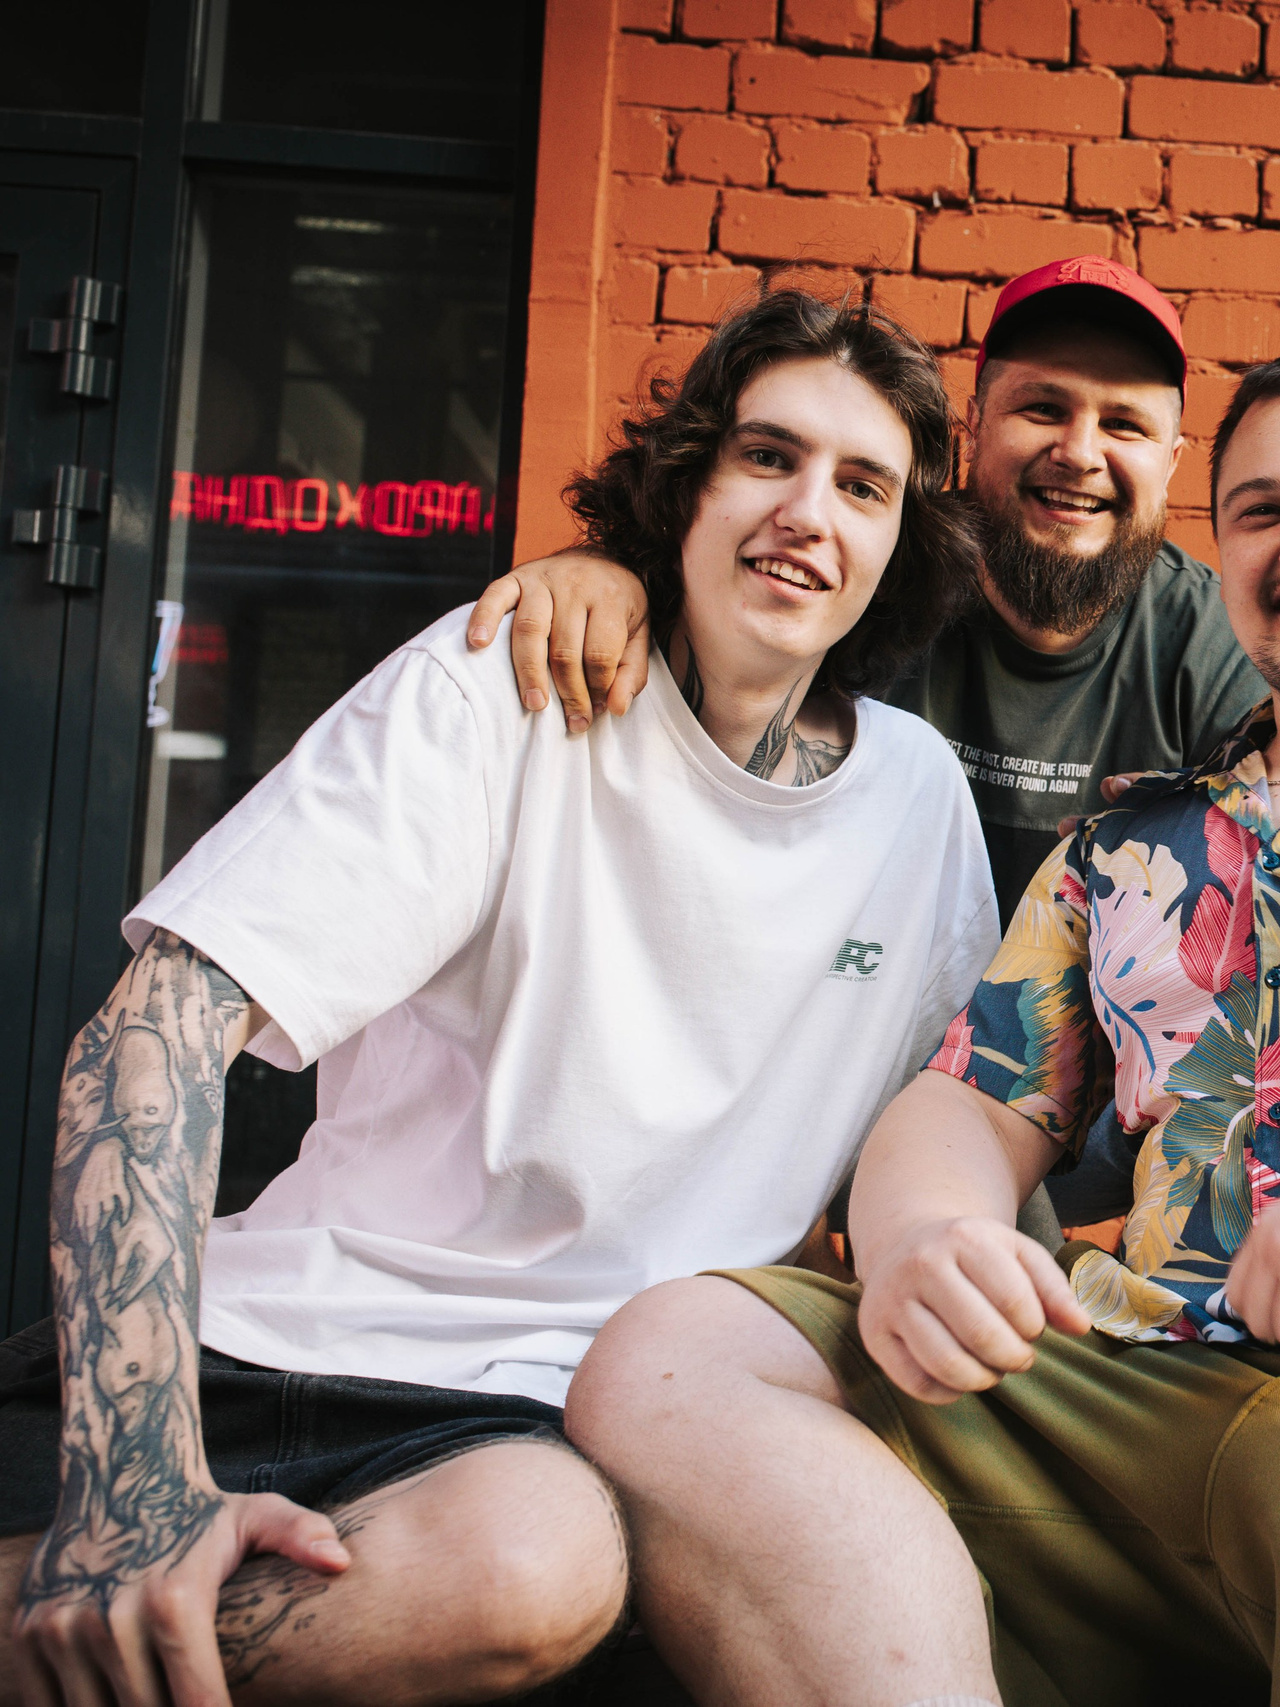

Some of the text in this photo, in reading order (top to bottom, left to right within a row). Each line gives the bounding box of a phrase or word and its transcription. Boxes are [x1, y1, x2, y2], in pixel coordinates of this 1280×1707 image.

[963, 745, 982, 762] THE
[1002, 756, 1039, 775] CREATE
[1039, 761, 1056, 777] THE
[960, 761, 1079, 795] IME IS NEVER FOUND AGAIN
